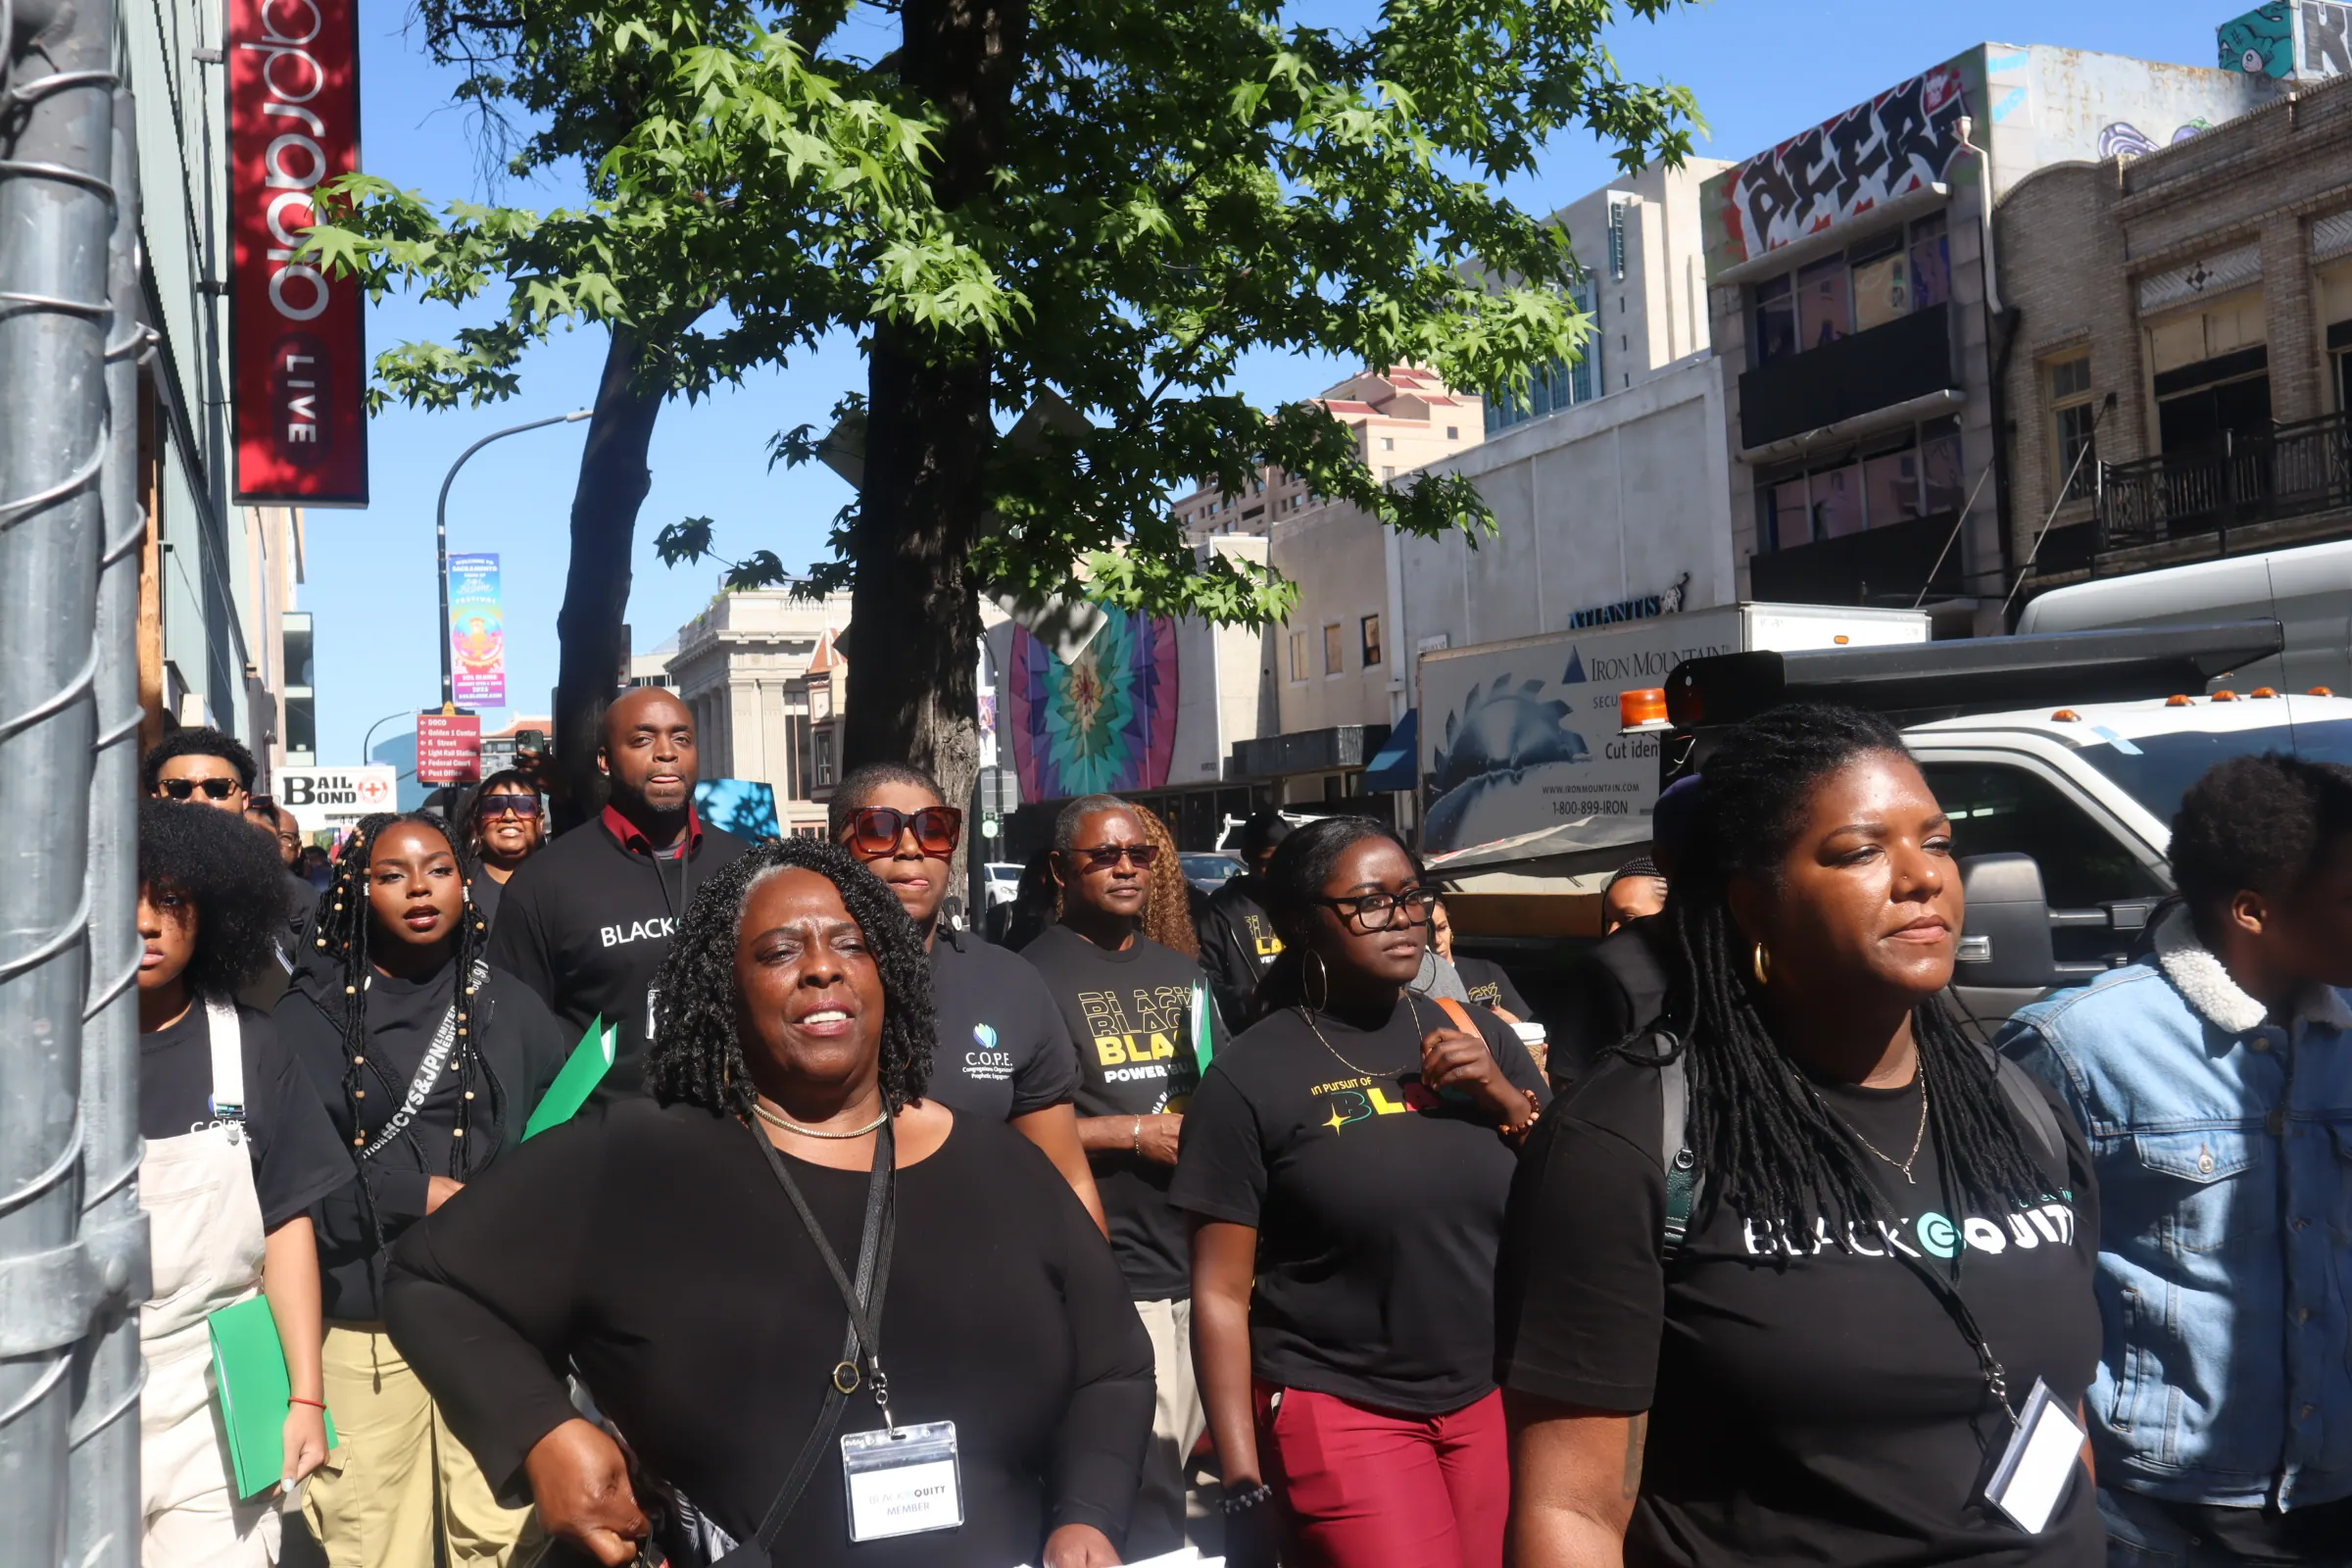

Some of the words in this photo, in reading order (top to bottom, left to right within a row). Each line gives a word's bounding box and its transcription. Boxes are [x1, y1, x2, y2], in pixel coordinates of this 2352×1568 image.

[286, 354, 317, 443] LIVE
[1568, 595, 1659, 629] ATLANTIS
[1592, 657, 1630, 682] IRON
[427, 749, 443, 758] Light
[1605, 742, 1627, 760] Cut
[1552, 802, 1628, 815] 1-800-899-IRON
[965, 1052, 1013, 1066] C.O.P.E.
[1104, 1064, 1168, 1084] POWER
[887, 1501, 930, 1516] MEMBER
